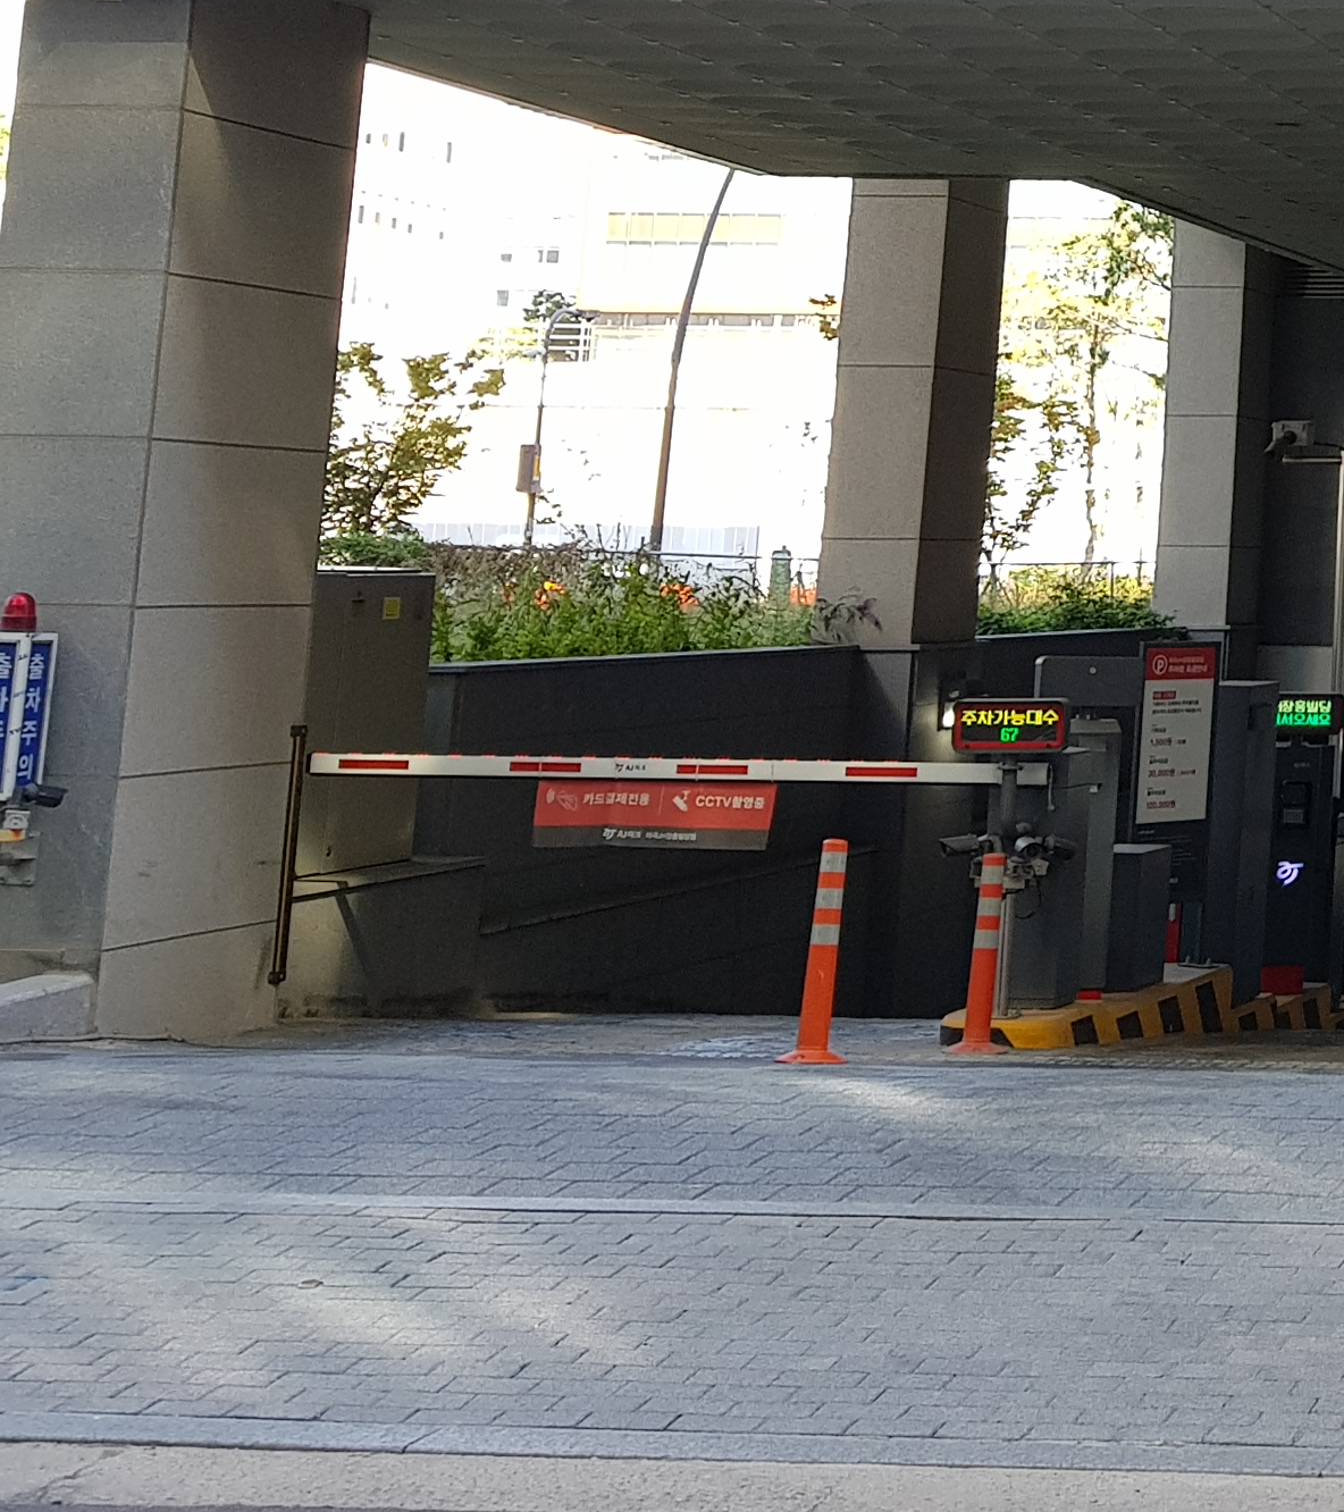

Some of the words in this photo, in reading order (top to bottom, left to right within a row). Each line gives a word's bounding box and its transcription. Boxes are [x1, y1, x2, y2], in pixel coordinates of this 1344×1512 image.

[17, 652, 45, 781] 출차주의
[960, 708, 1060, 726] 주차가능대수
[1000, 727, 1019, 742] 67
